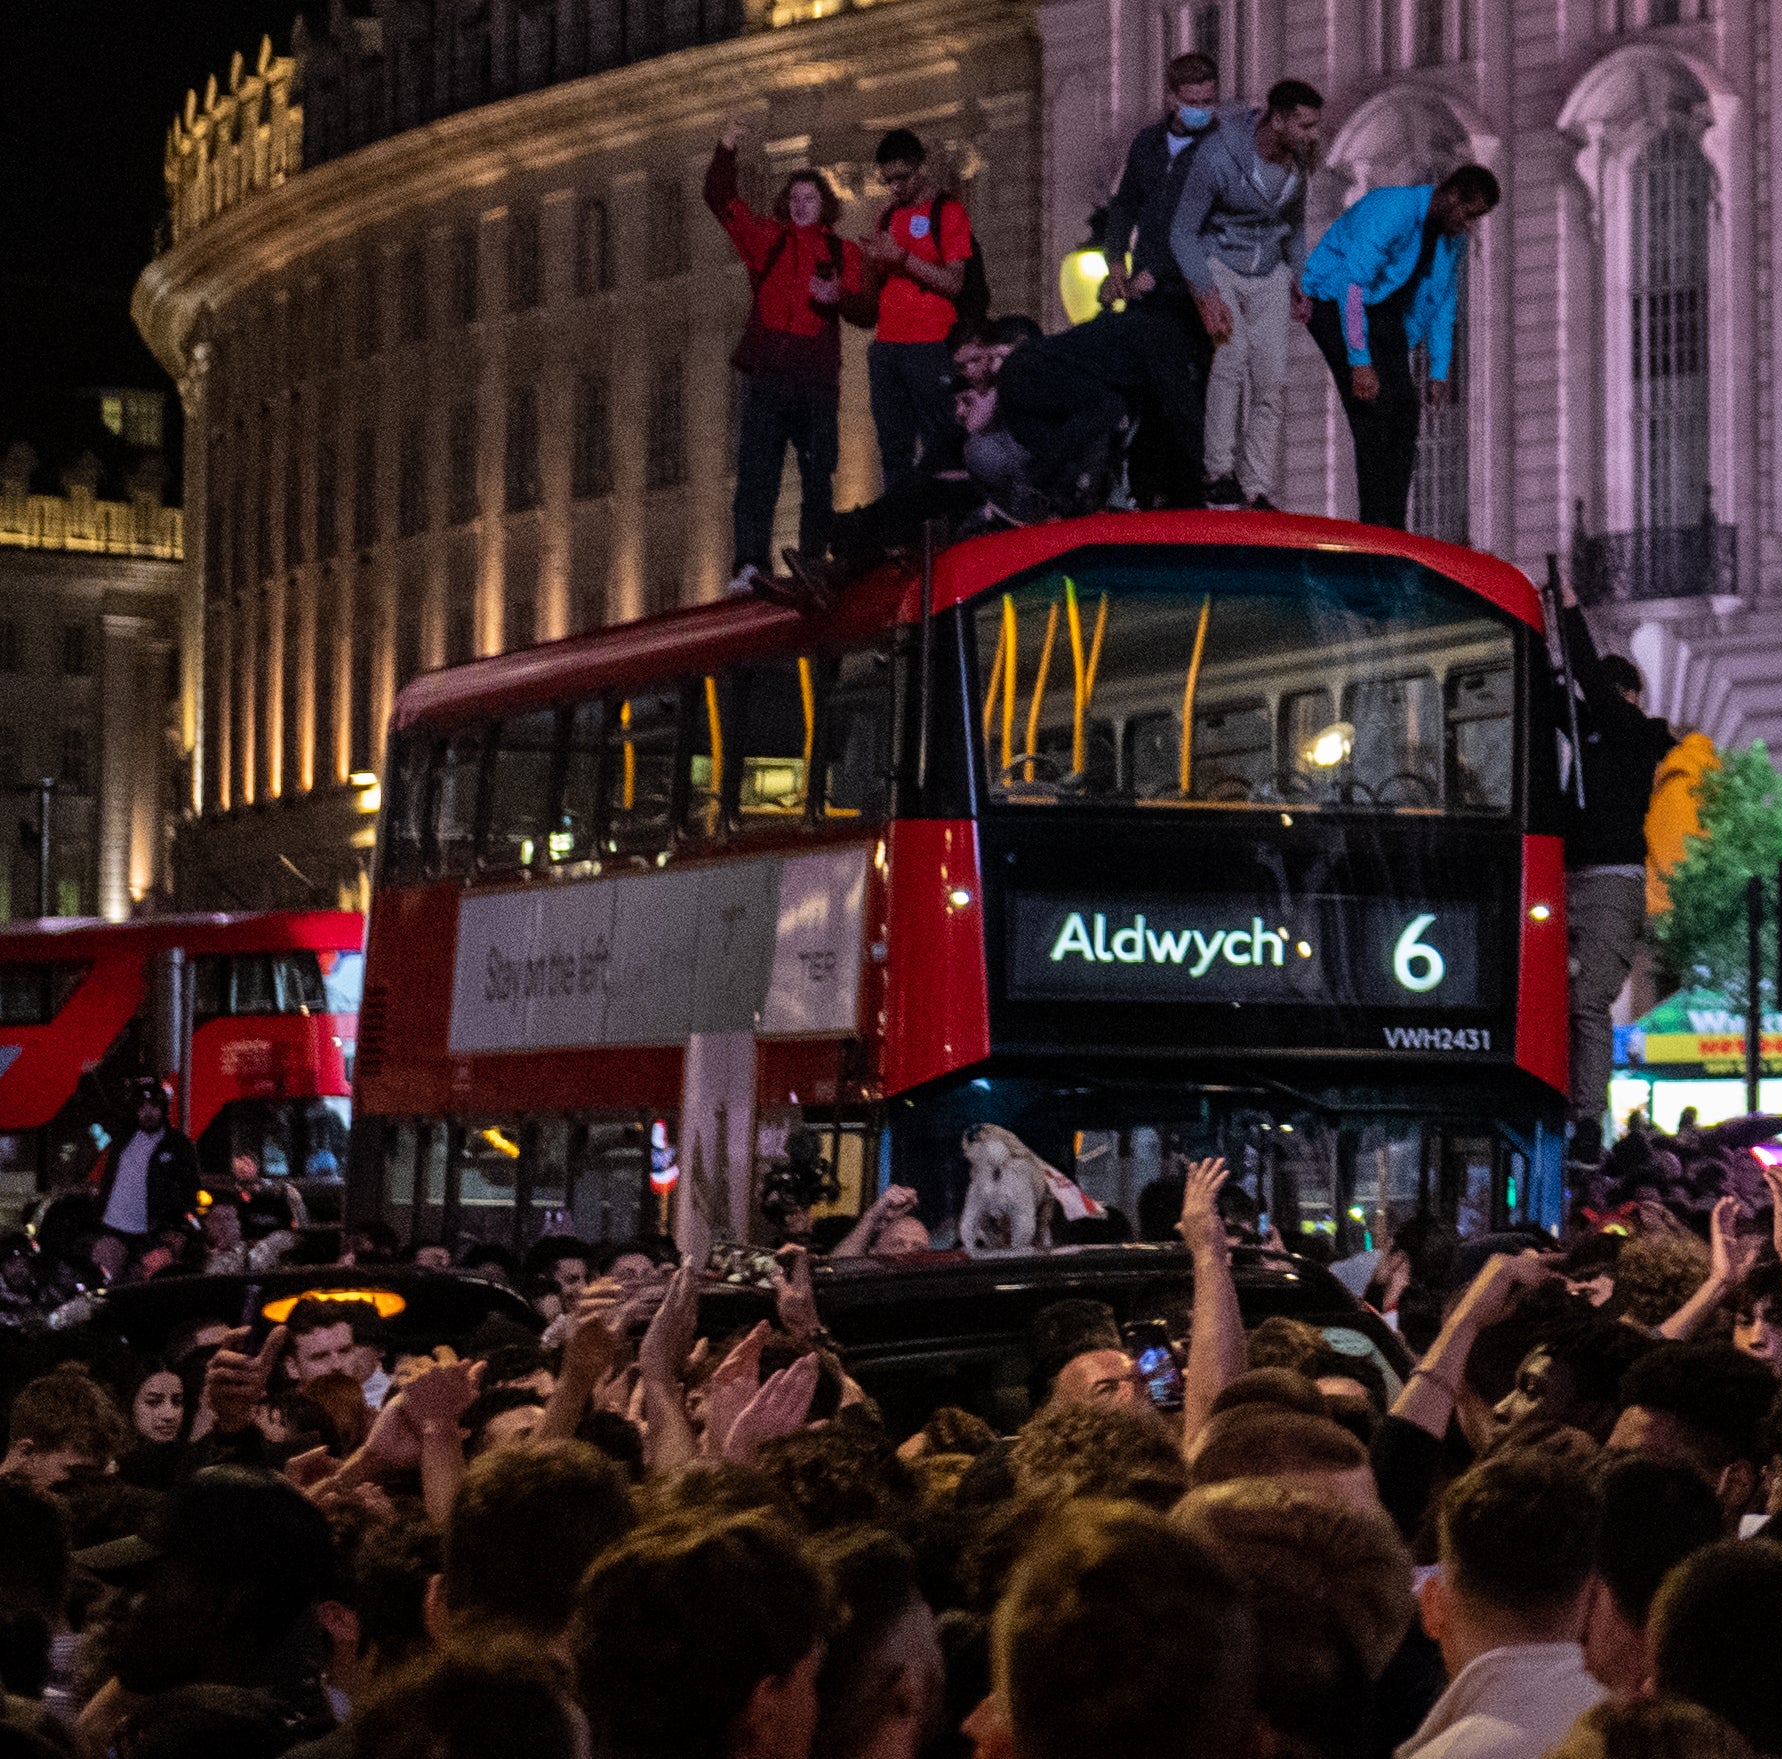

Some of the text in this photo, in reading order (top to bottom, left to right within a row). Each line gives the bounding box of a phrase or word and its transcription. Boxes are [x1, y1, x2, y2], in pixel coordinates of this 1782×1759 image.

[1050, 912, 1285, 978] Aldwych
[1394, 914, 1446, 993] 6
[1382, 1026, 1491, 1051] VWH2431
